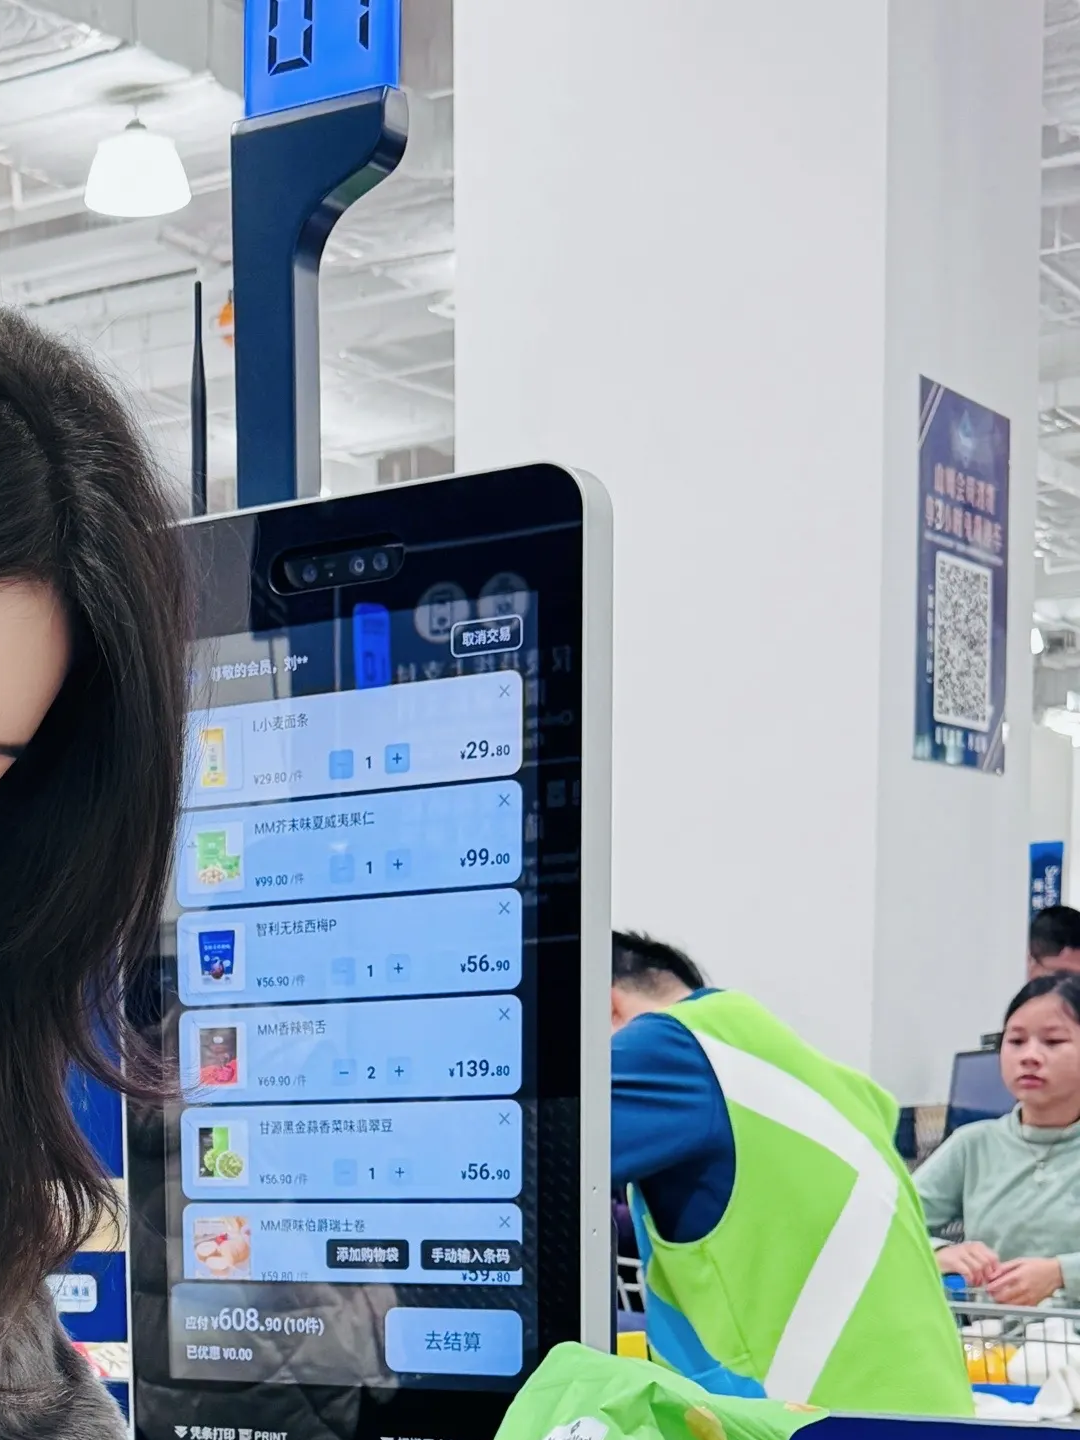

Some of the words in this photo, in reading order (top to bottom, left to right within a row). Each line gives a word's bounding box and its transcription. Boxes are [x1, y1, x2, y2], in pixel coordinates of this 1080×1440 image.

[462, 627, 510, 648] 取消交易
[460, 739, 510, 760] ¥29.80
[365, 756, 373, 769] 1
[254, 811, 375, 835] MM芥末味夏威夷果仁
[460, 848, 510, 867] ¥99.00
[366, 861, 373, 874] 1
[256, 919, 337, 937] 智利无核西梅P
[367, 965, 374, 977] 1
[460, 955, 510, 973] ¥56.90
[257, 1020, 327, 1036] MM香辣鸭舌
[367, 1067, 376, 1079] 2
[448, 1059, 510, 1078] ¥139.80
[259, 1119, 393, 1136] 甘源黑金蒜香菜味翡翠豆
[369, 1168, 376, 1180] 1
[461, 1163, 510, 1181] ¥56.90
[260, 1219, 366, 1234] MM原味伯爵瑞士卷
[336, 1246, 399, 1263] 添加购物袋
[431, 1247, 511, 1265] 手动输入条码
[425, 1331, 482, 1352] 去结算
[186, 1345, 221, 1361] 已优惠
[223, 1347, 253, 1362] ¥0.00
